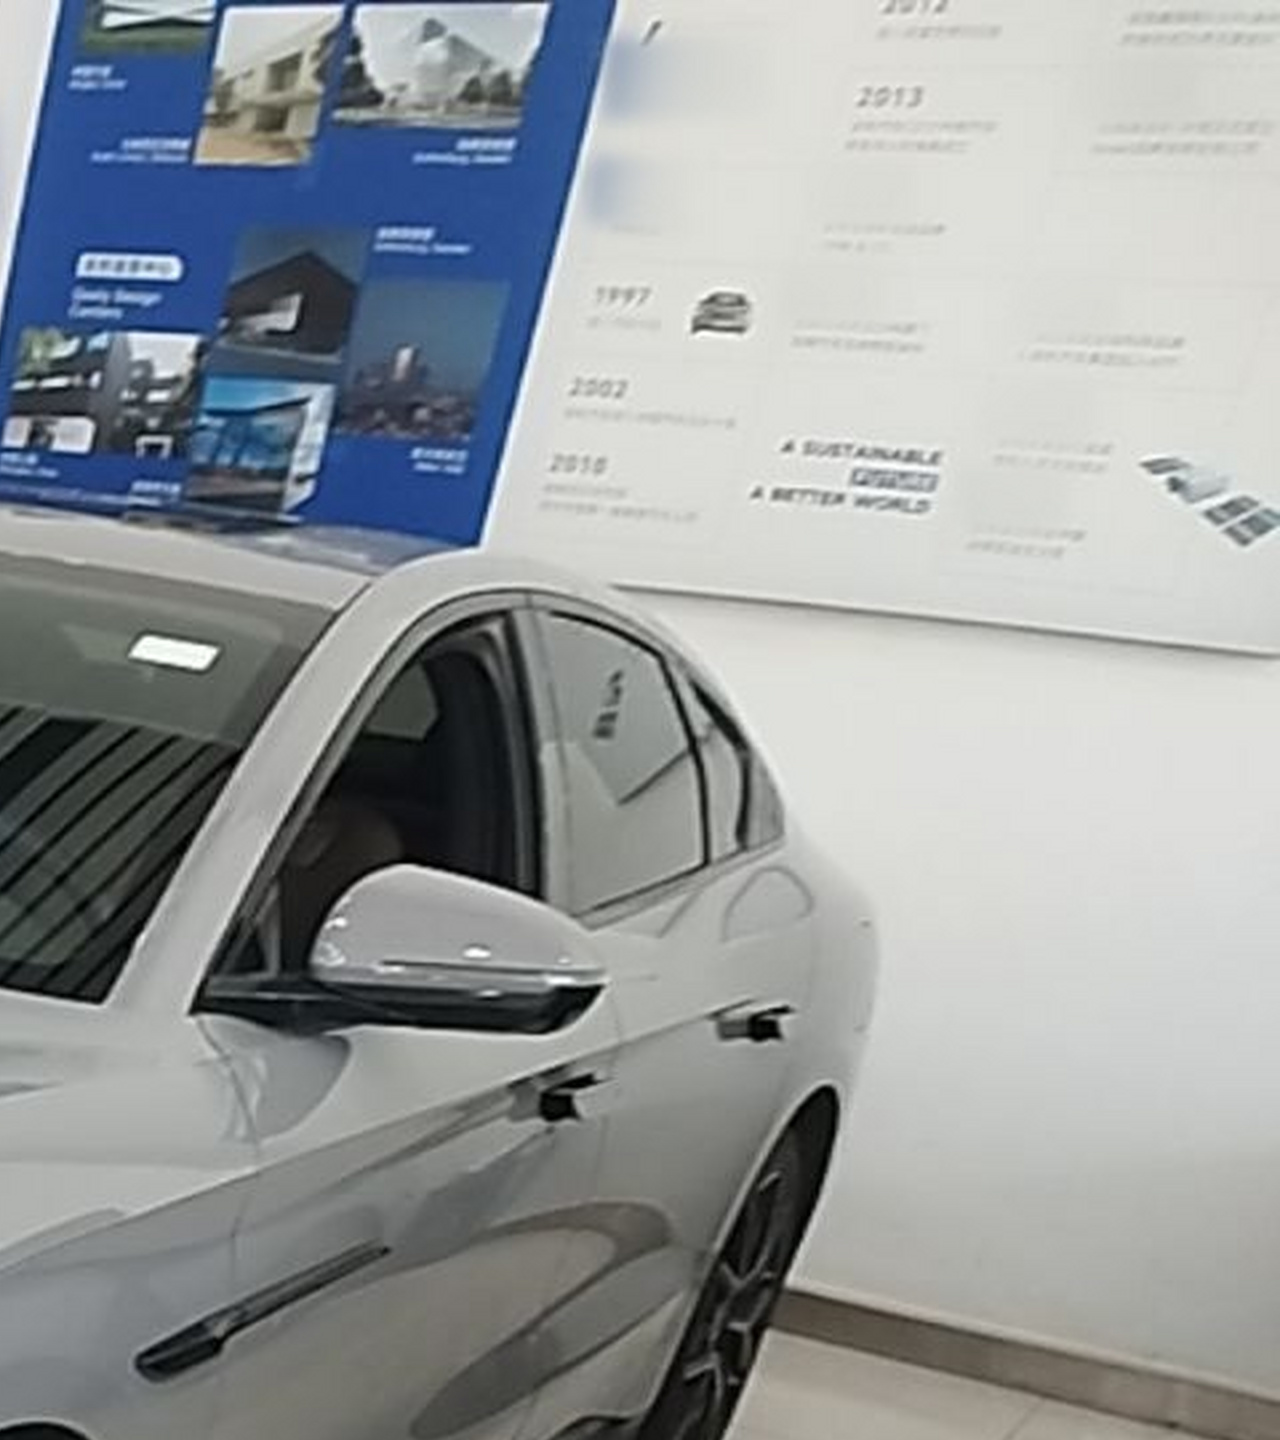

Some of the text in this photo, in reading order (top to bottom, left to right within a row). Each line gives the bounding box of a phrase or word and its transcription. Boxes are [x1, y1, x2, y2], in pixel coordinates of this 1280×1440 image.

[856, 85, 925, 108] 2013
[596, 286, 652, 305] 1997
[568, 377, 629, 399] 2002
[802, 441, 943, 465] SUSTAINABLE
[770, 488, 845, 506] BETTER
[853, 496, 931, 514] WORLD
